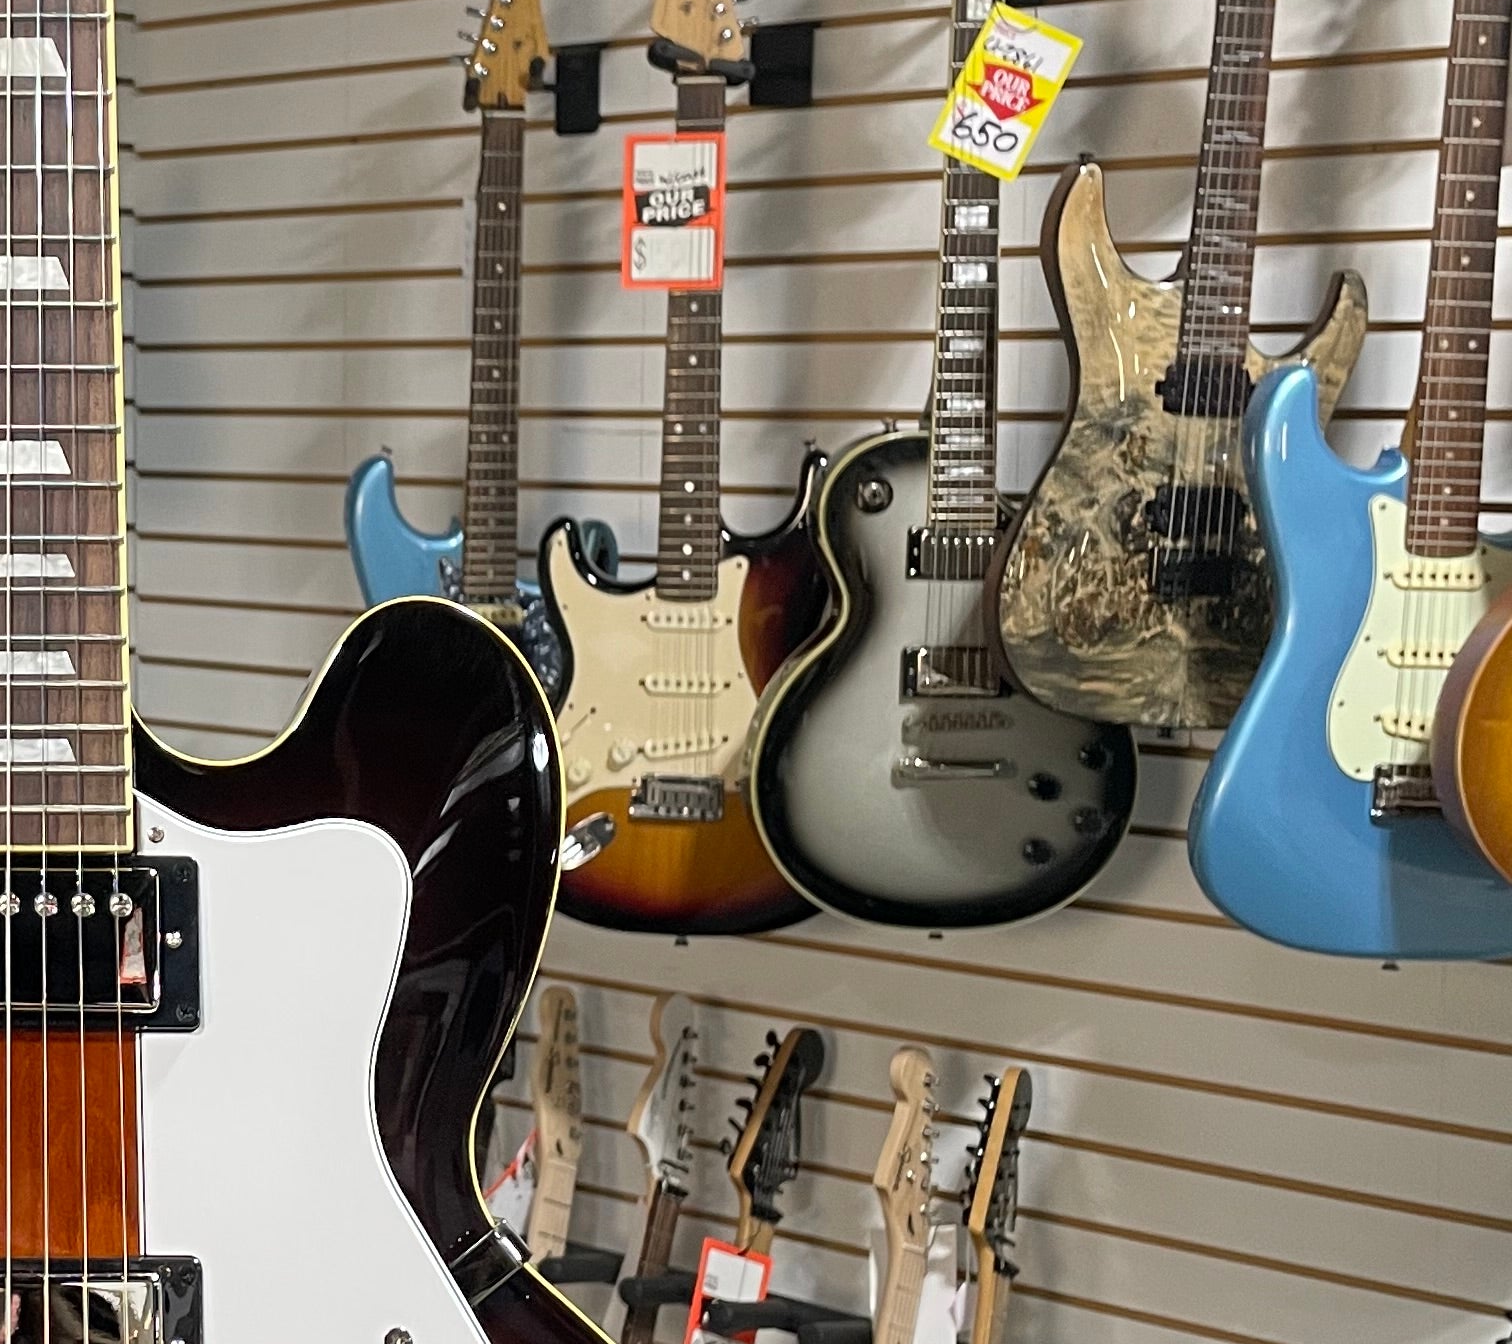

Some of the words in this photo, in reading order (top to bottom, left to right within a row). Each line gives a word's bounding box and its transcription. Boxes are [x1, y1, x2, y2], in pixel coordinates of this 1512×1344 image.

[980, 79, 1031, 113] PRICE
[992, 68, 1031, 98] OUR
[641, 198, 706, 225] PRICE
[649, 188, 695, 207] OUR
